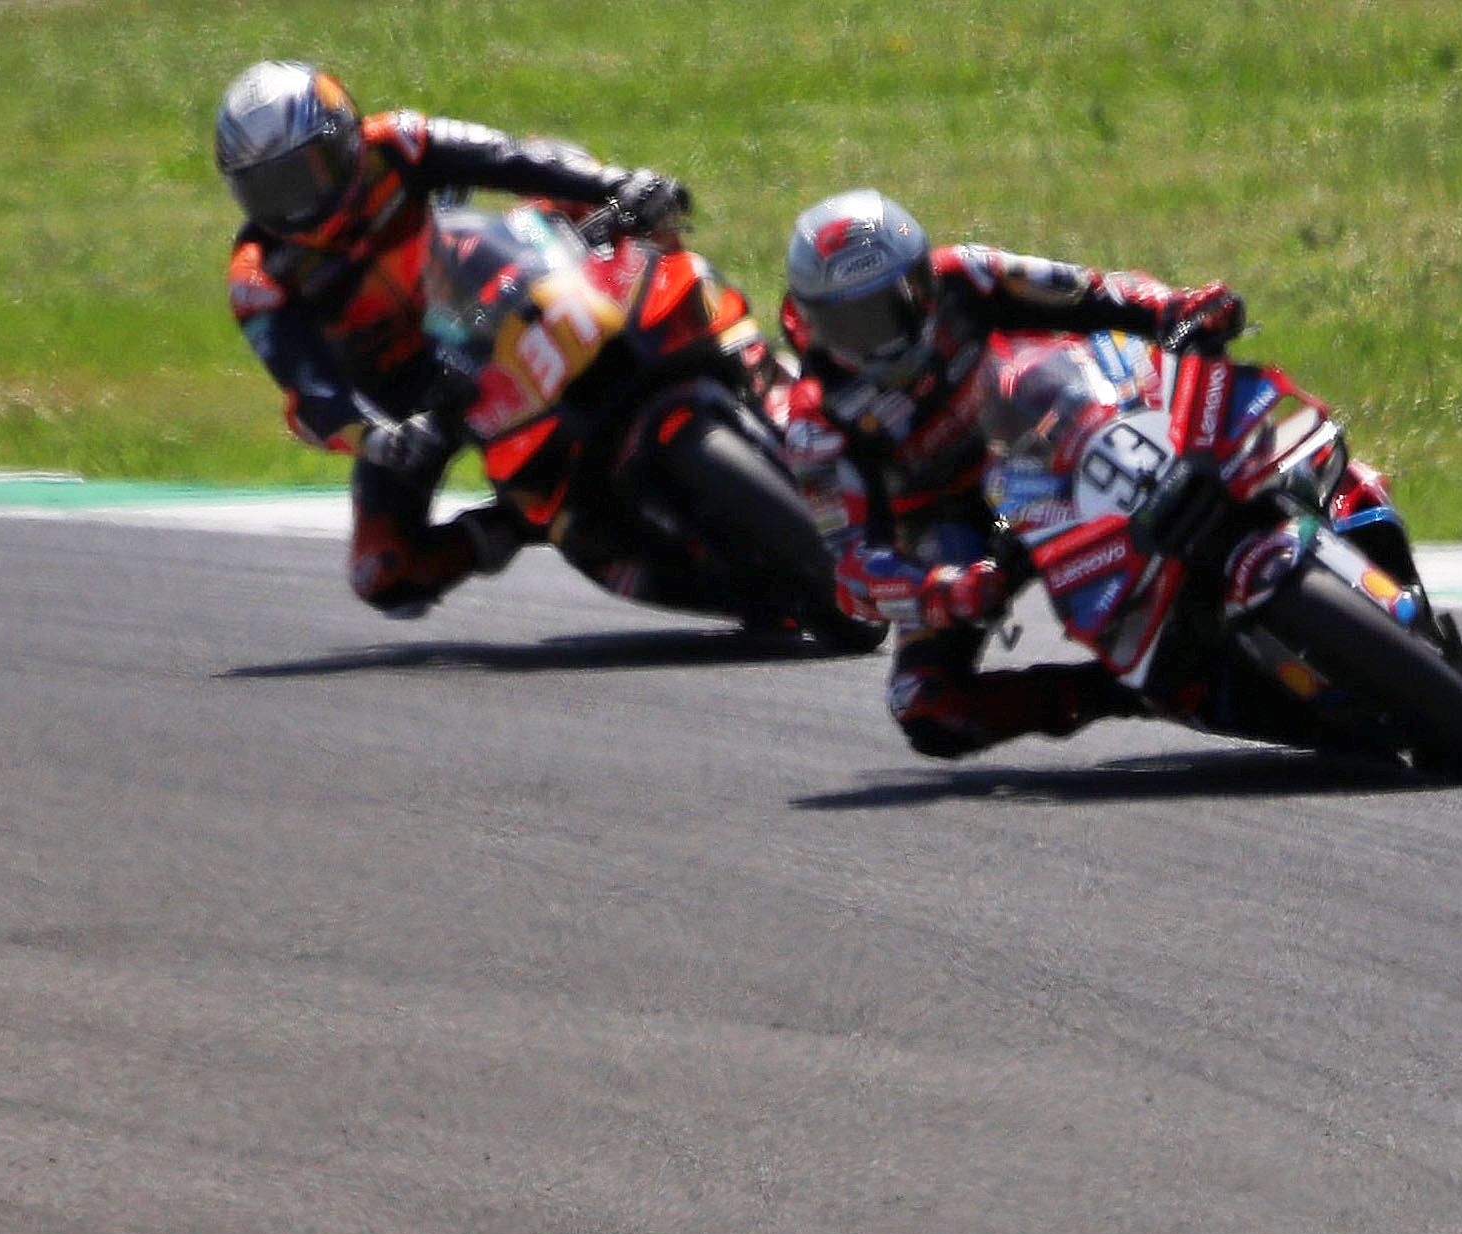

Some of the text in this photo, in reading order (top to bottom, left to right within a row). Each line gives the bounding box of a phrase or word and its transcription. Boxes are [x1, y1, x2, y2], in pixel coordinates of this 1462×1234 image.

[1194, 361, 1228, 446] Lenovo
[1084, 423, 1168, 512] 93
[1050, 541, 1126, 589] Lenovo
